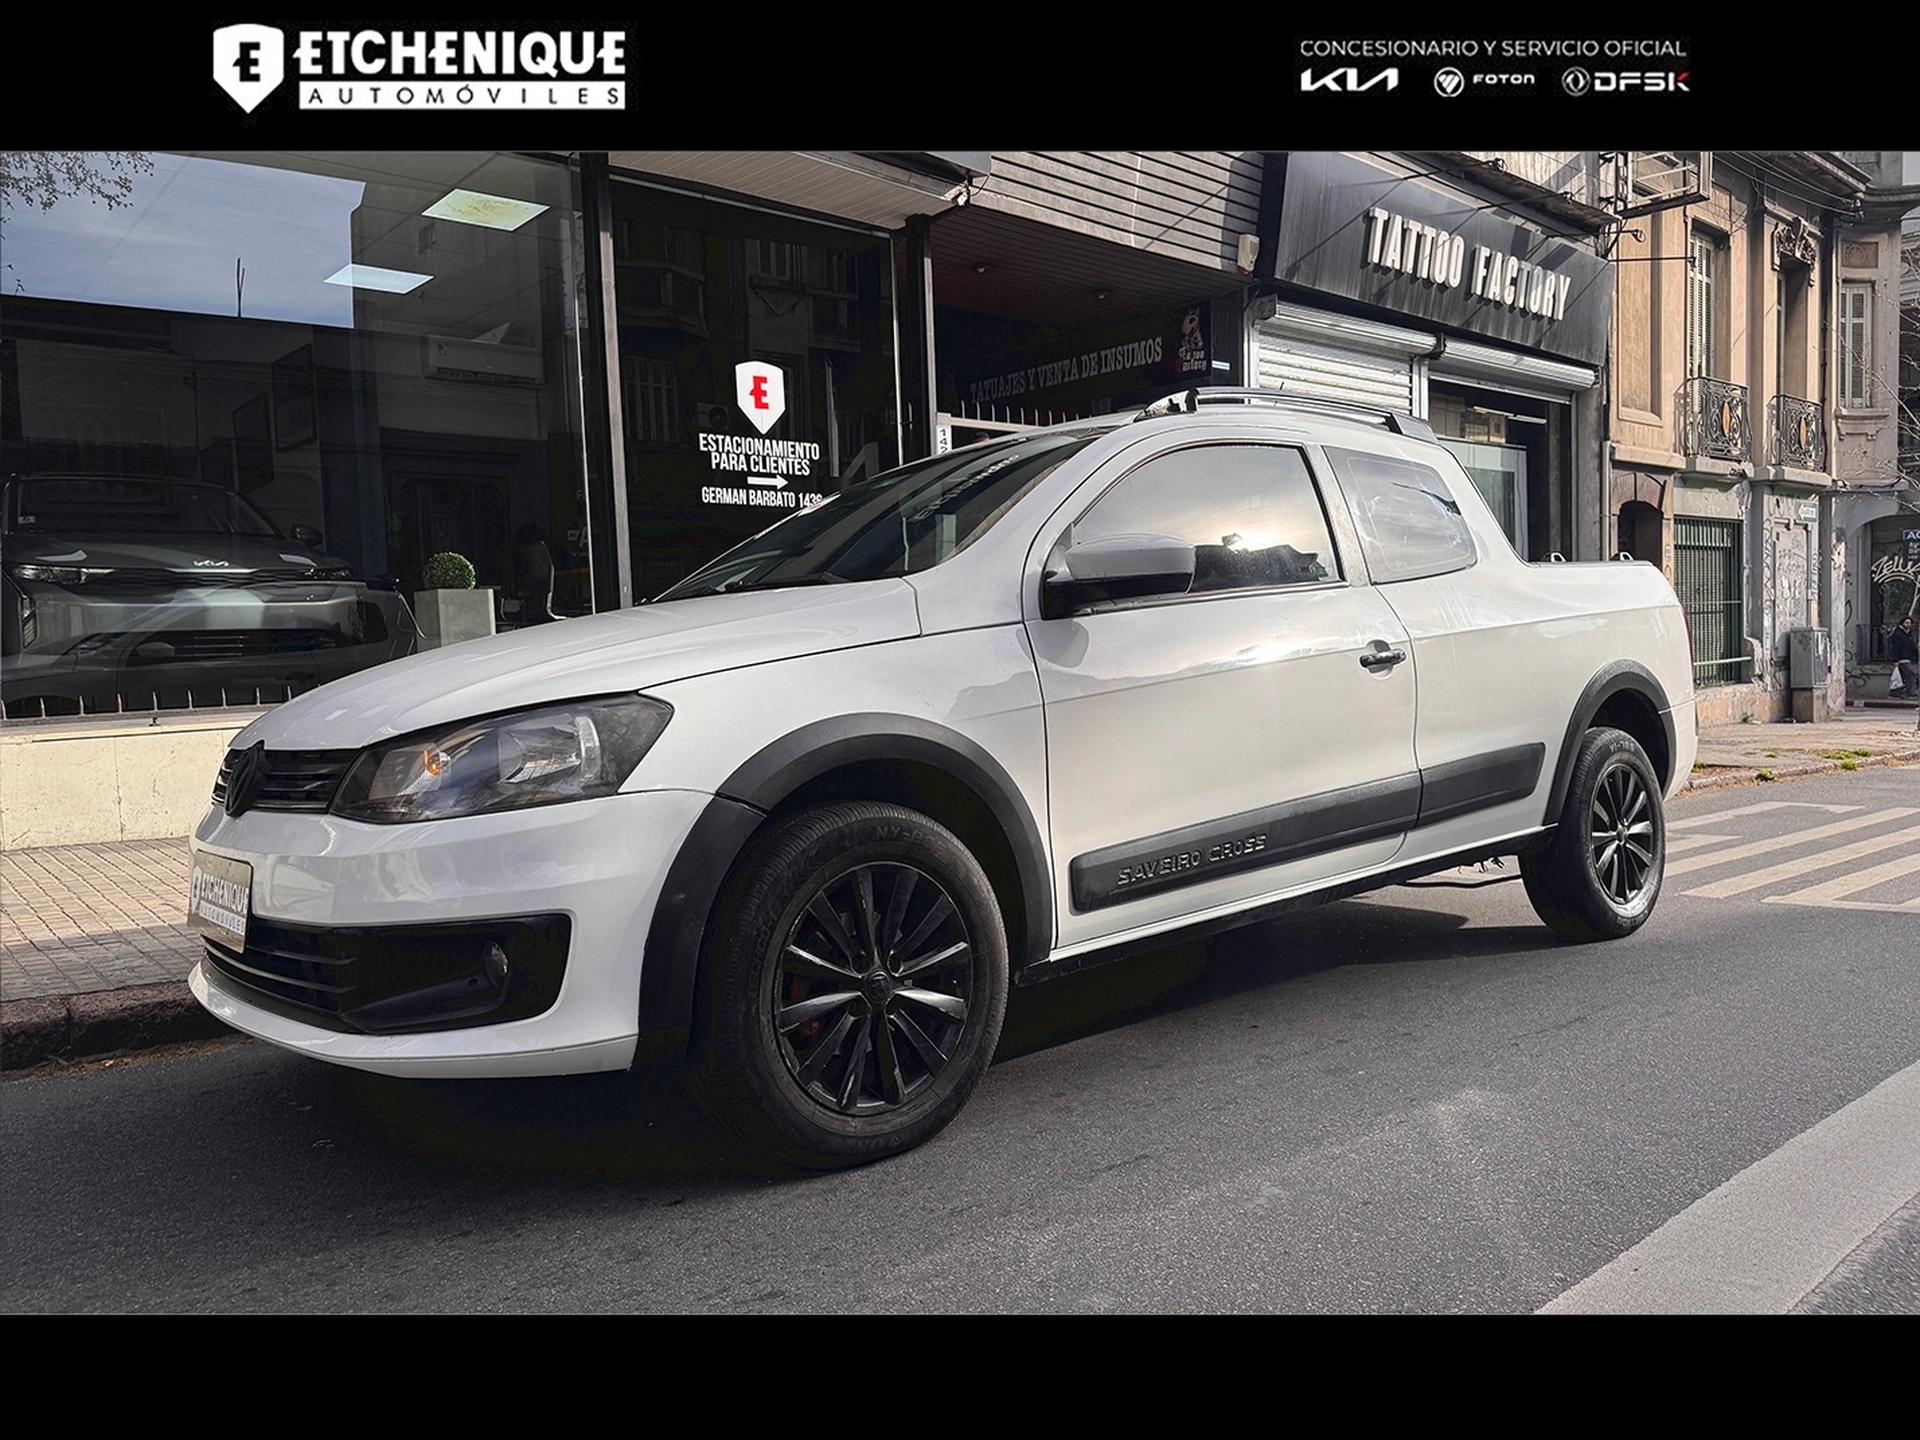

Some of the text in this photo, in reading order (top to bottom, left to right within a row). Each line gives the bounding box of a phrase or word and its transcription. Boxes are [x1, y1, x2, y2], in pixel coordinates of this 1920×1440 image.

[1368, 207, 1572, 321] TATTOO FACTORY
[969, 336, 1163, 404] TATUAJES Y VENTA DE INSUMOS
[698, 432, 820, 461] ESTACIONAMIENTO
[711, 451, 811, 477] PARA CLIENTES
[701, 486, 747, 507] GERMAN
[749, 489, 796, 509] BARBATO
[1116, 833, 1268, 887] SAVEIRO CROSS
